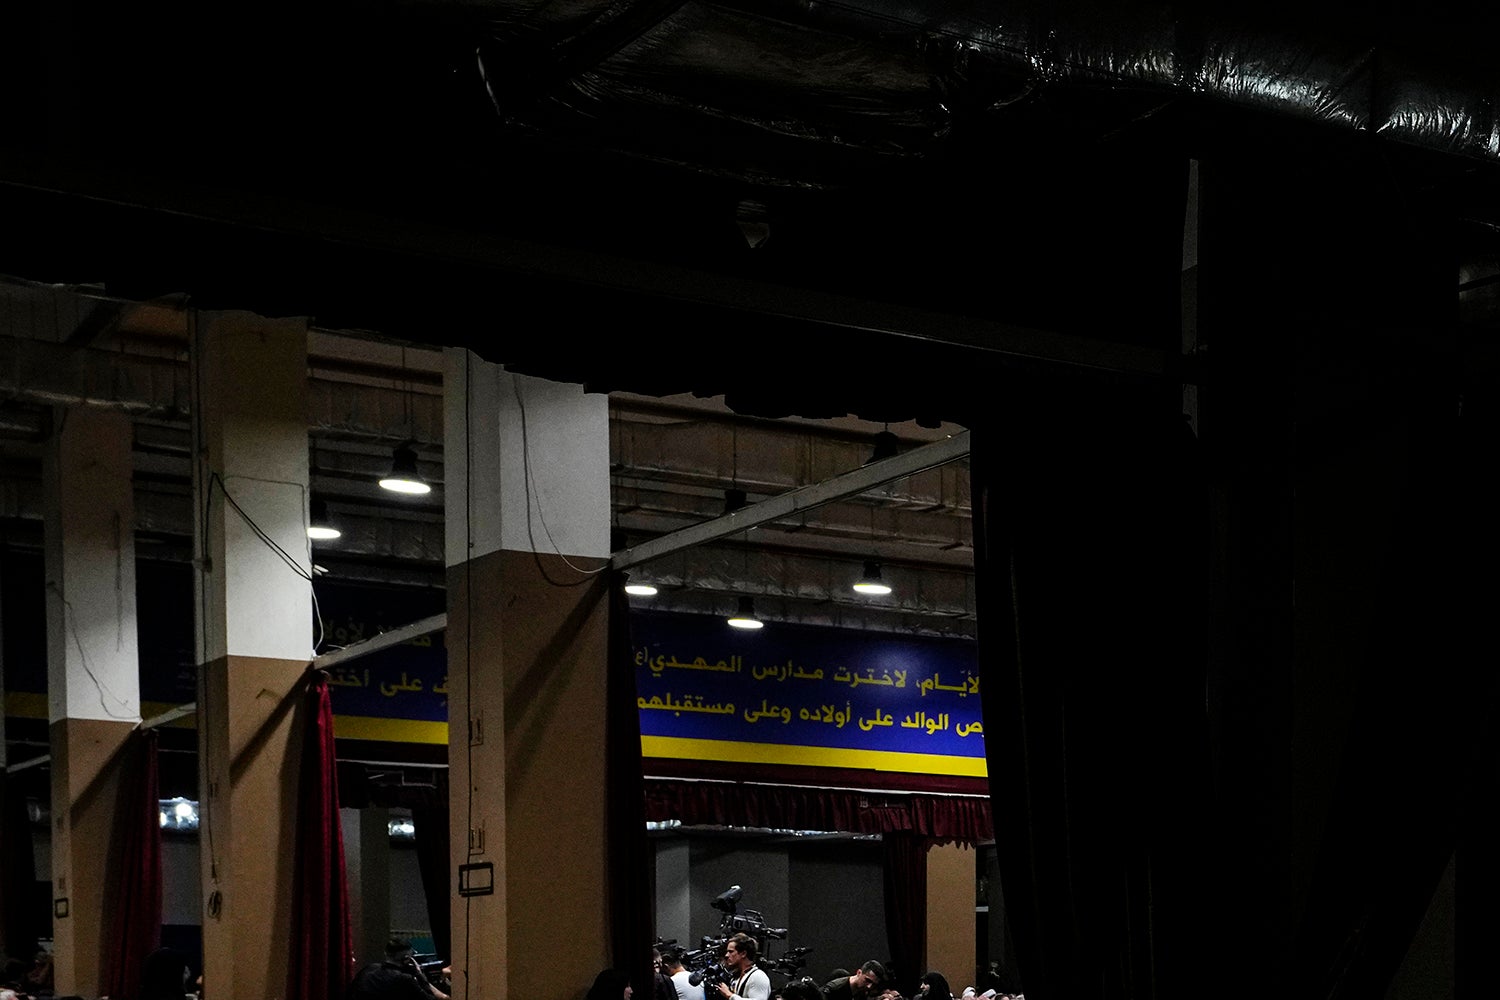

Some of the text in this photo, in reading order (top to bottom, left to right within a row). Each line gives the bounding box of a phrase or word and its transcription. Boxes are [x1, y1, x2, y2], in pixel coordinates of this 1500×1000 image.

[752, 659, 824, 682] مدارس
[833, 666, 907, 688] لاخترت
[744, 699, 792, 724] وعلى
[800, 701, 851, 728] أولاده
[858, 708, 894, 731] على
[900, 711, 949, 735] الوالد
